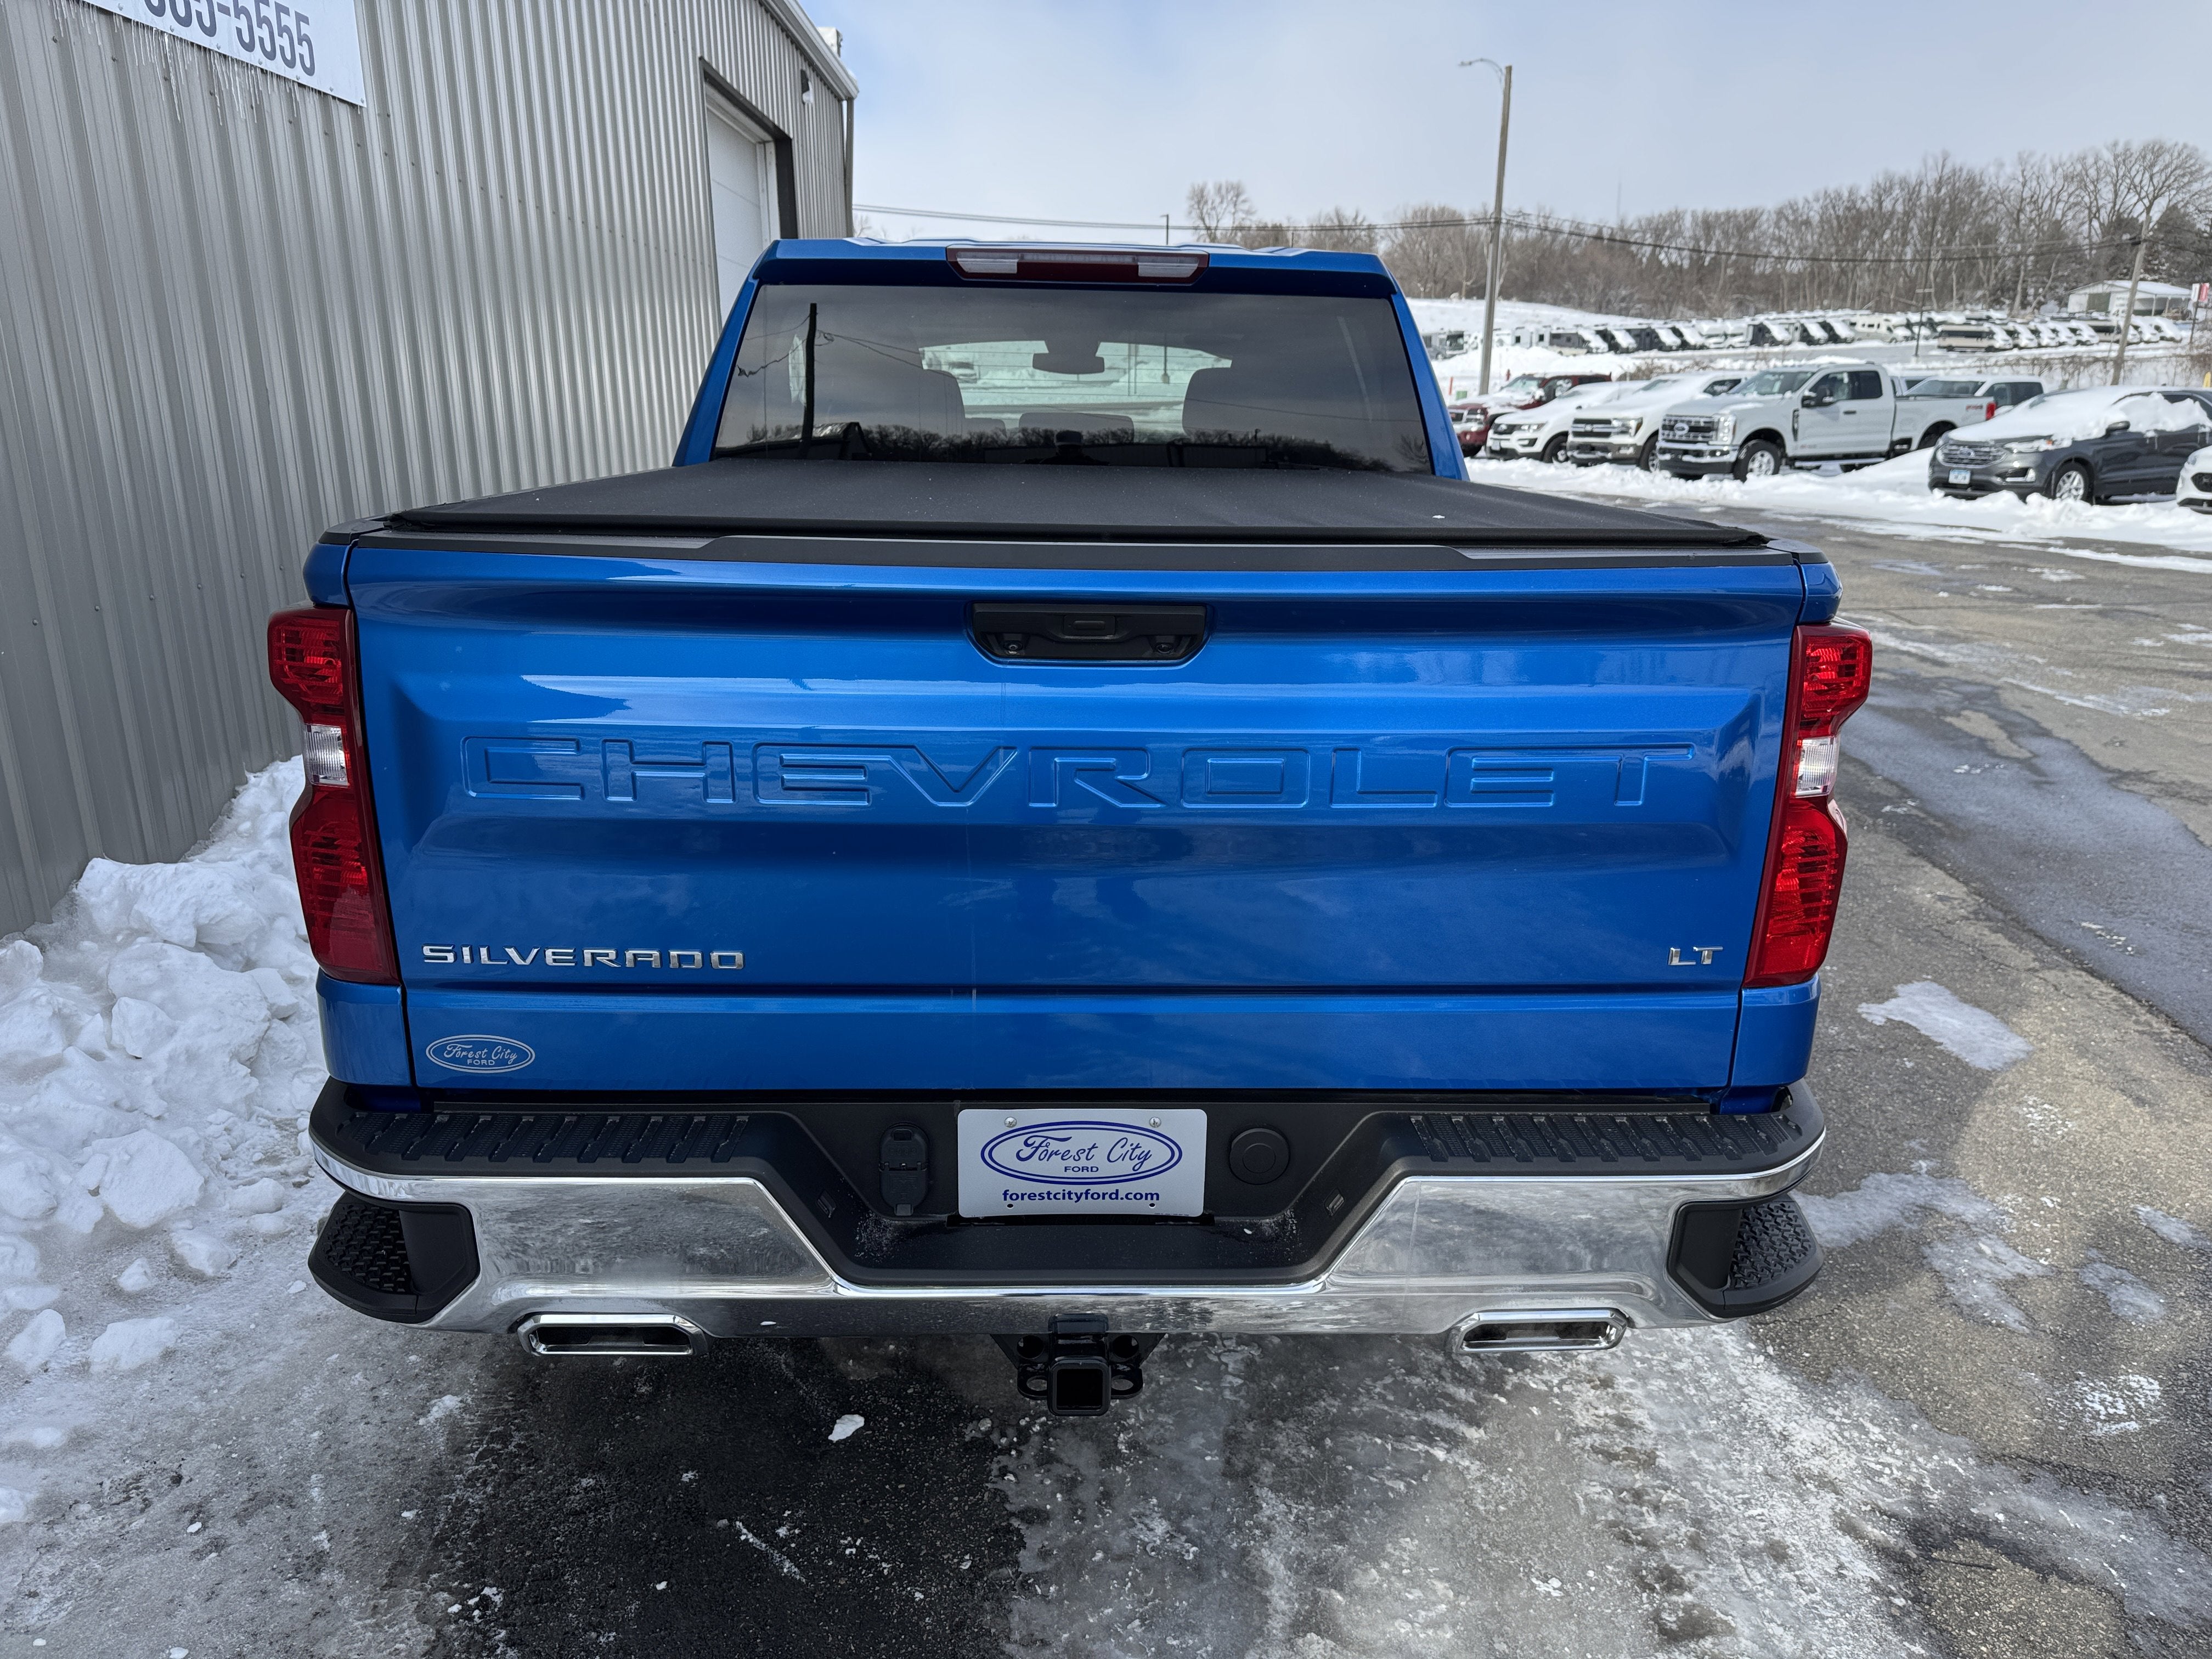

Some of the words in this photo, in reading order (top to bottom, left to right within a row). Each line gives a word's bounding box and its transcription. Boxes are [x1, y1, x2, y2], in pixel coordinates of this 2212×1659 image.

[144, 0, 315, 77] 5-5555
[460, 736, 1696, 809] CHEVROLET
[422, 944, 744, 969] SILVERADO
[1668, 945, 1724, 966] LT
[443, 1043, 488, 1059] Forest
[491, 1045, 518, 1065] City
[1015, 1135, 1099, 1162] Forest
[1107, 1137, 1153, 1172] City
[1002, 1188, 1160, 1203] forestcityford.com
